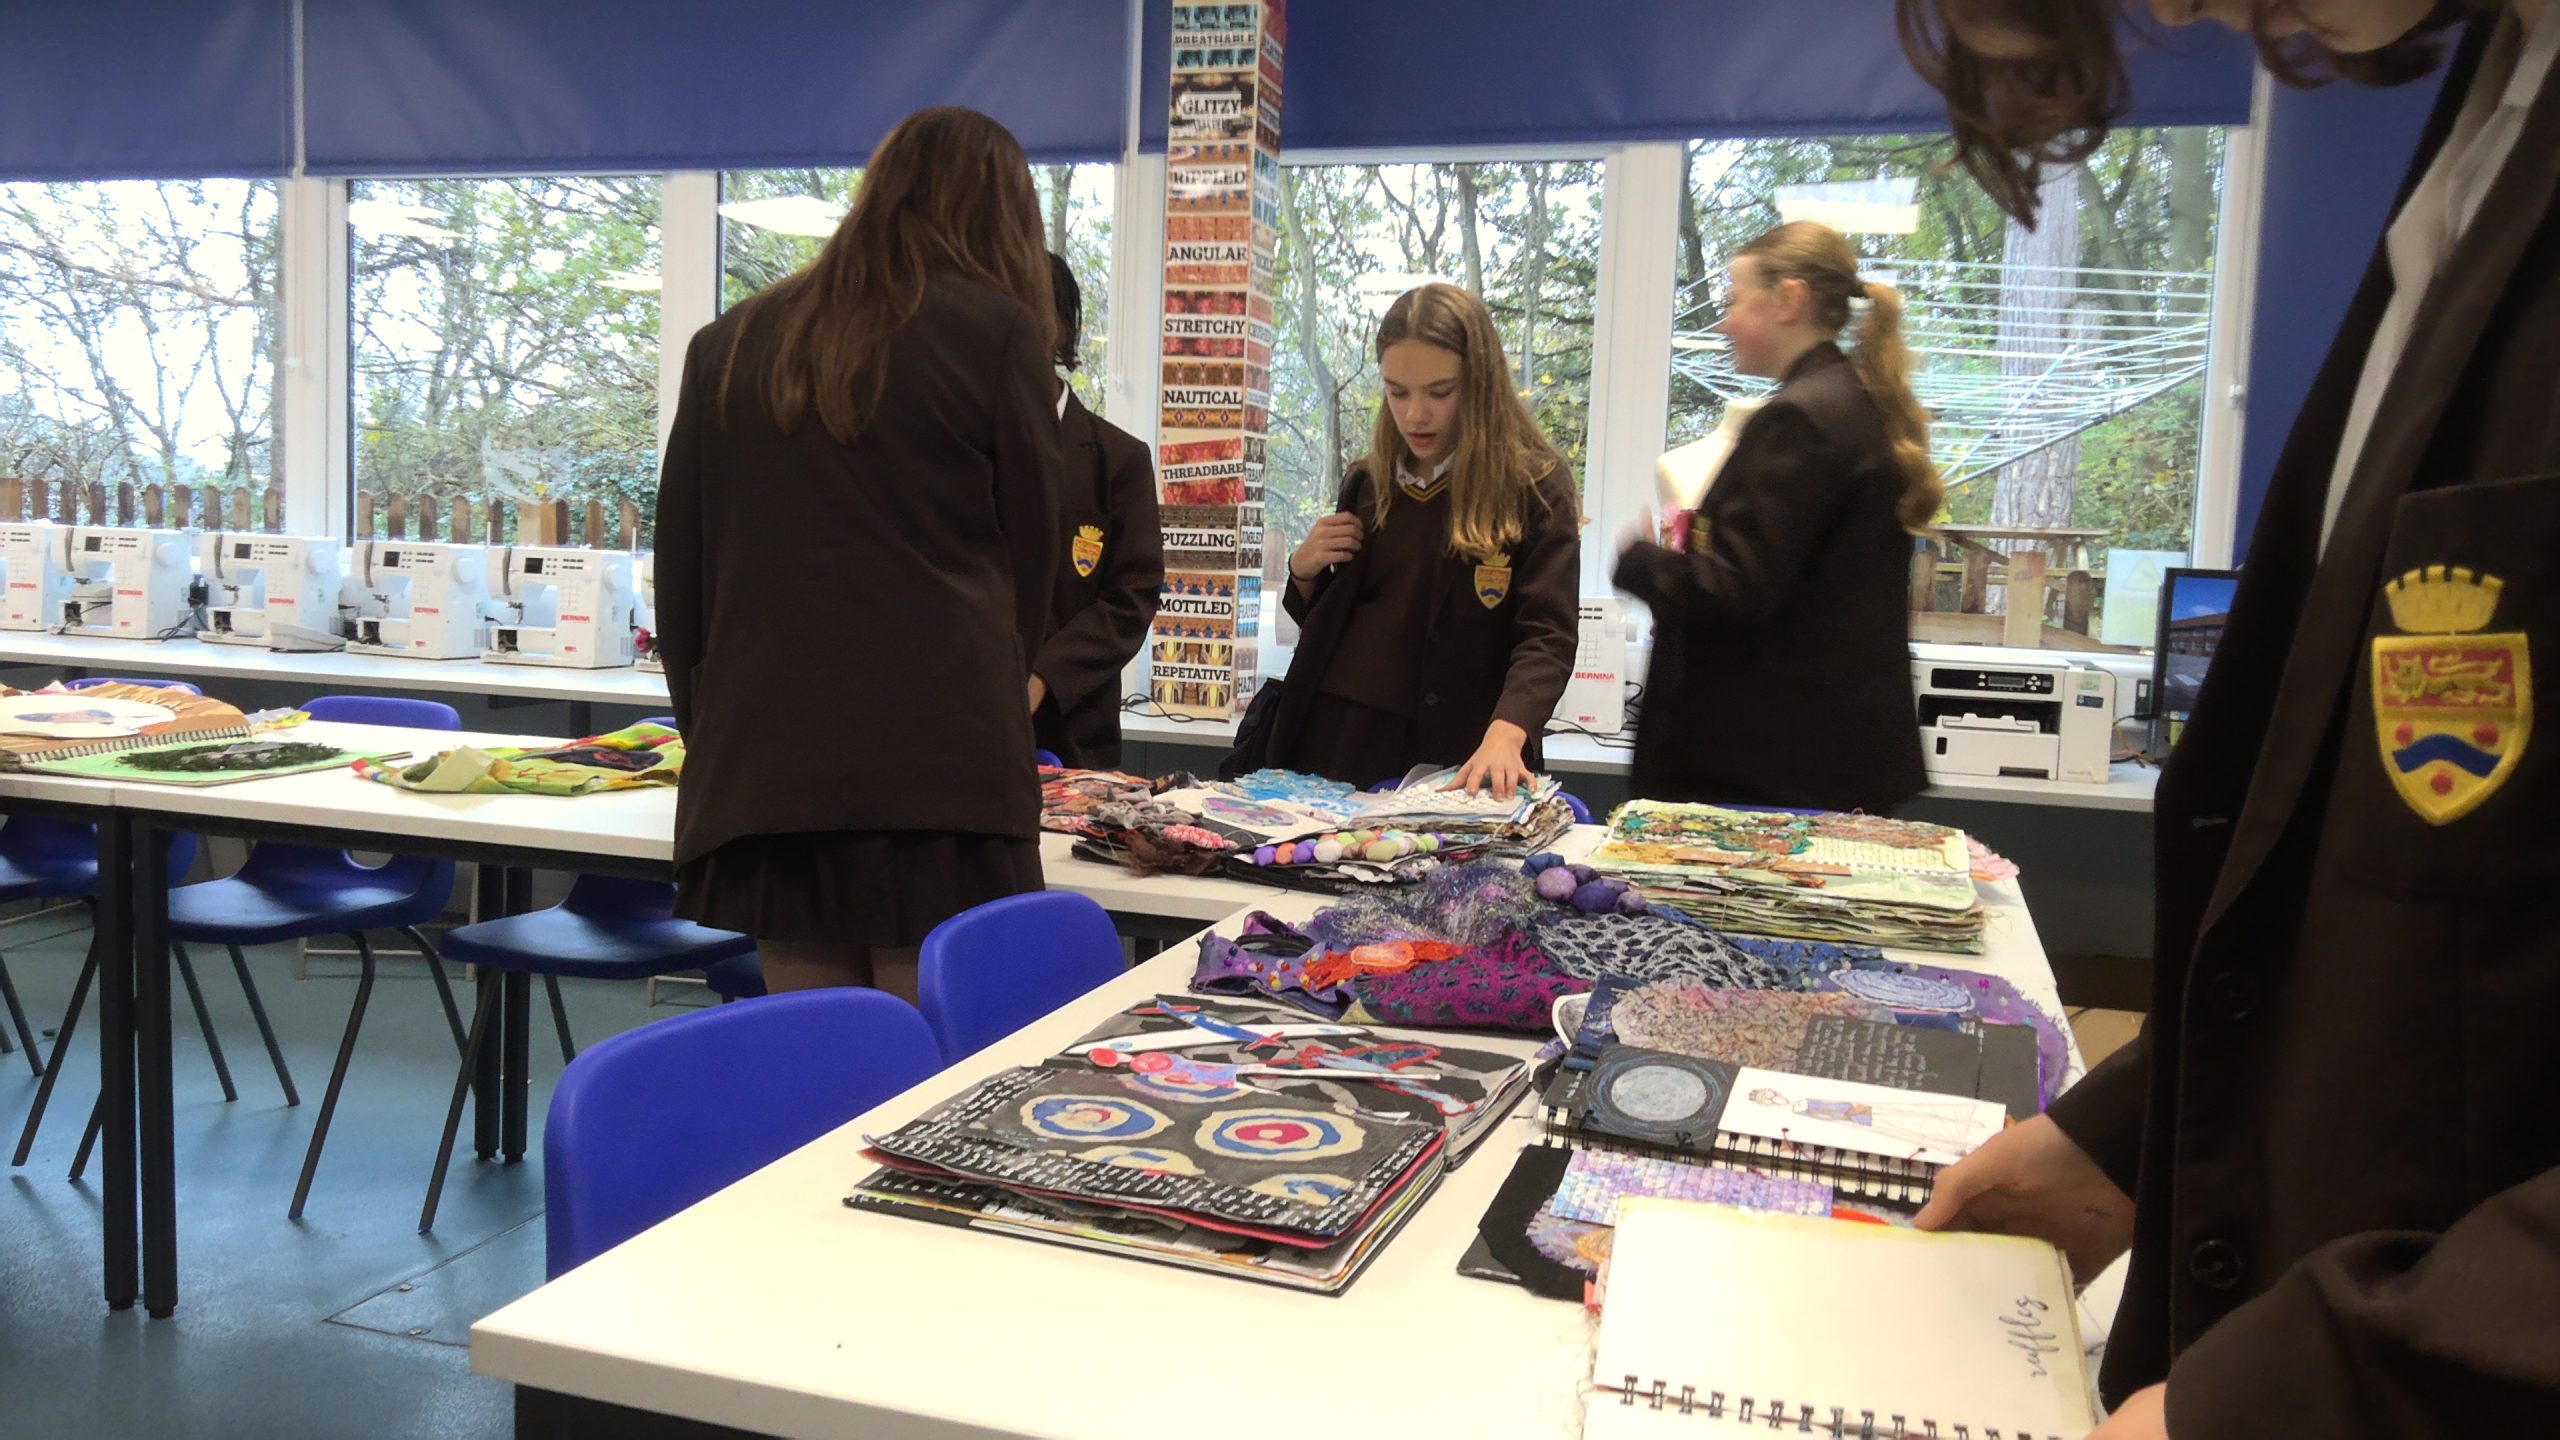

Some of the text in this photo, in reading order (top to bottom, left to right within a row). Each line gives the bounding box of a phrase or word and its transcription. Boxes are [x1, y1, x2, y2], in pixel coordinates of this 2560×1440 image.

[1182, 99, 1241, 115] GLITZY
[1168, 246, 1247, 263] ANGULAR
[1164, 319, 1245, 335] STRETCHY
[1163, 390, 1242, 406] NAUTICAL
[1161, 462, 1244, 480] THREADBARE
[1161, 533, 1236, 548] PUZZLING
[1159, 599, 1232, 616] MOTTLED
[1153, 665, 1231, 682] REPETATIVE
[1574, 672, 1615, 680] BERNINA
